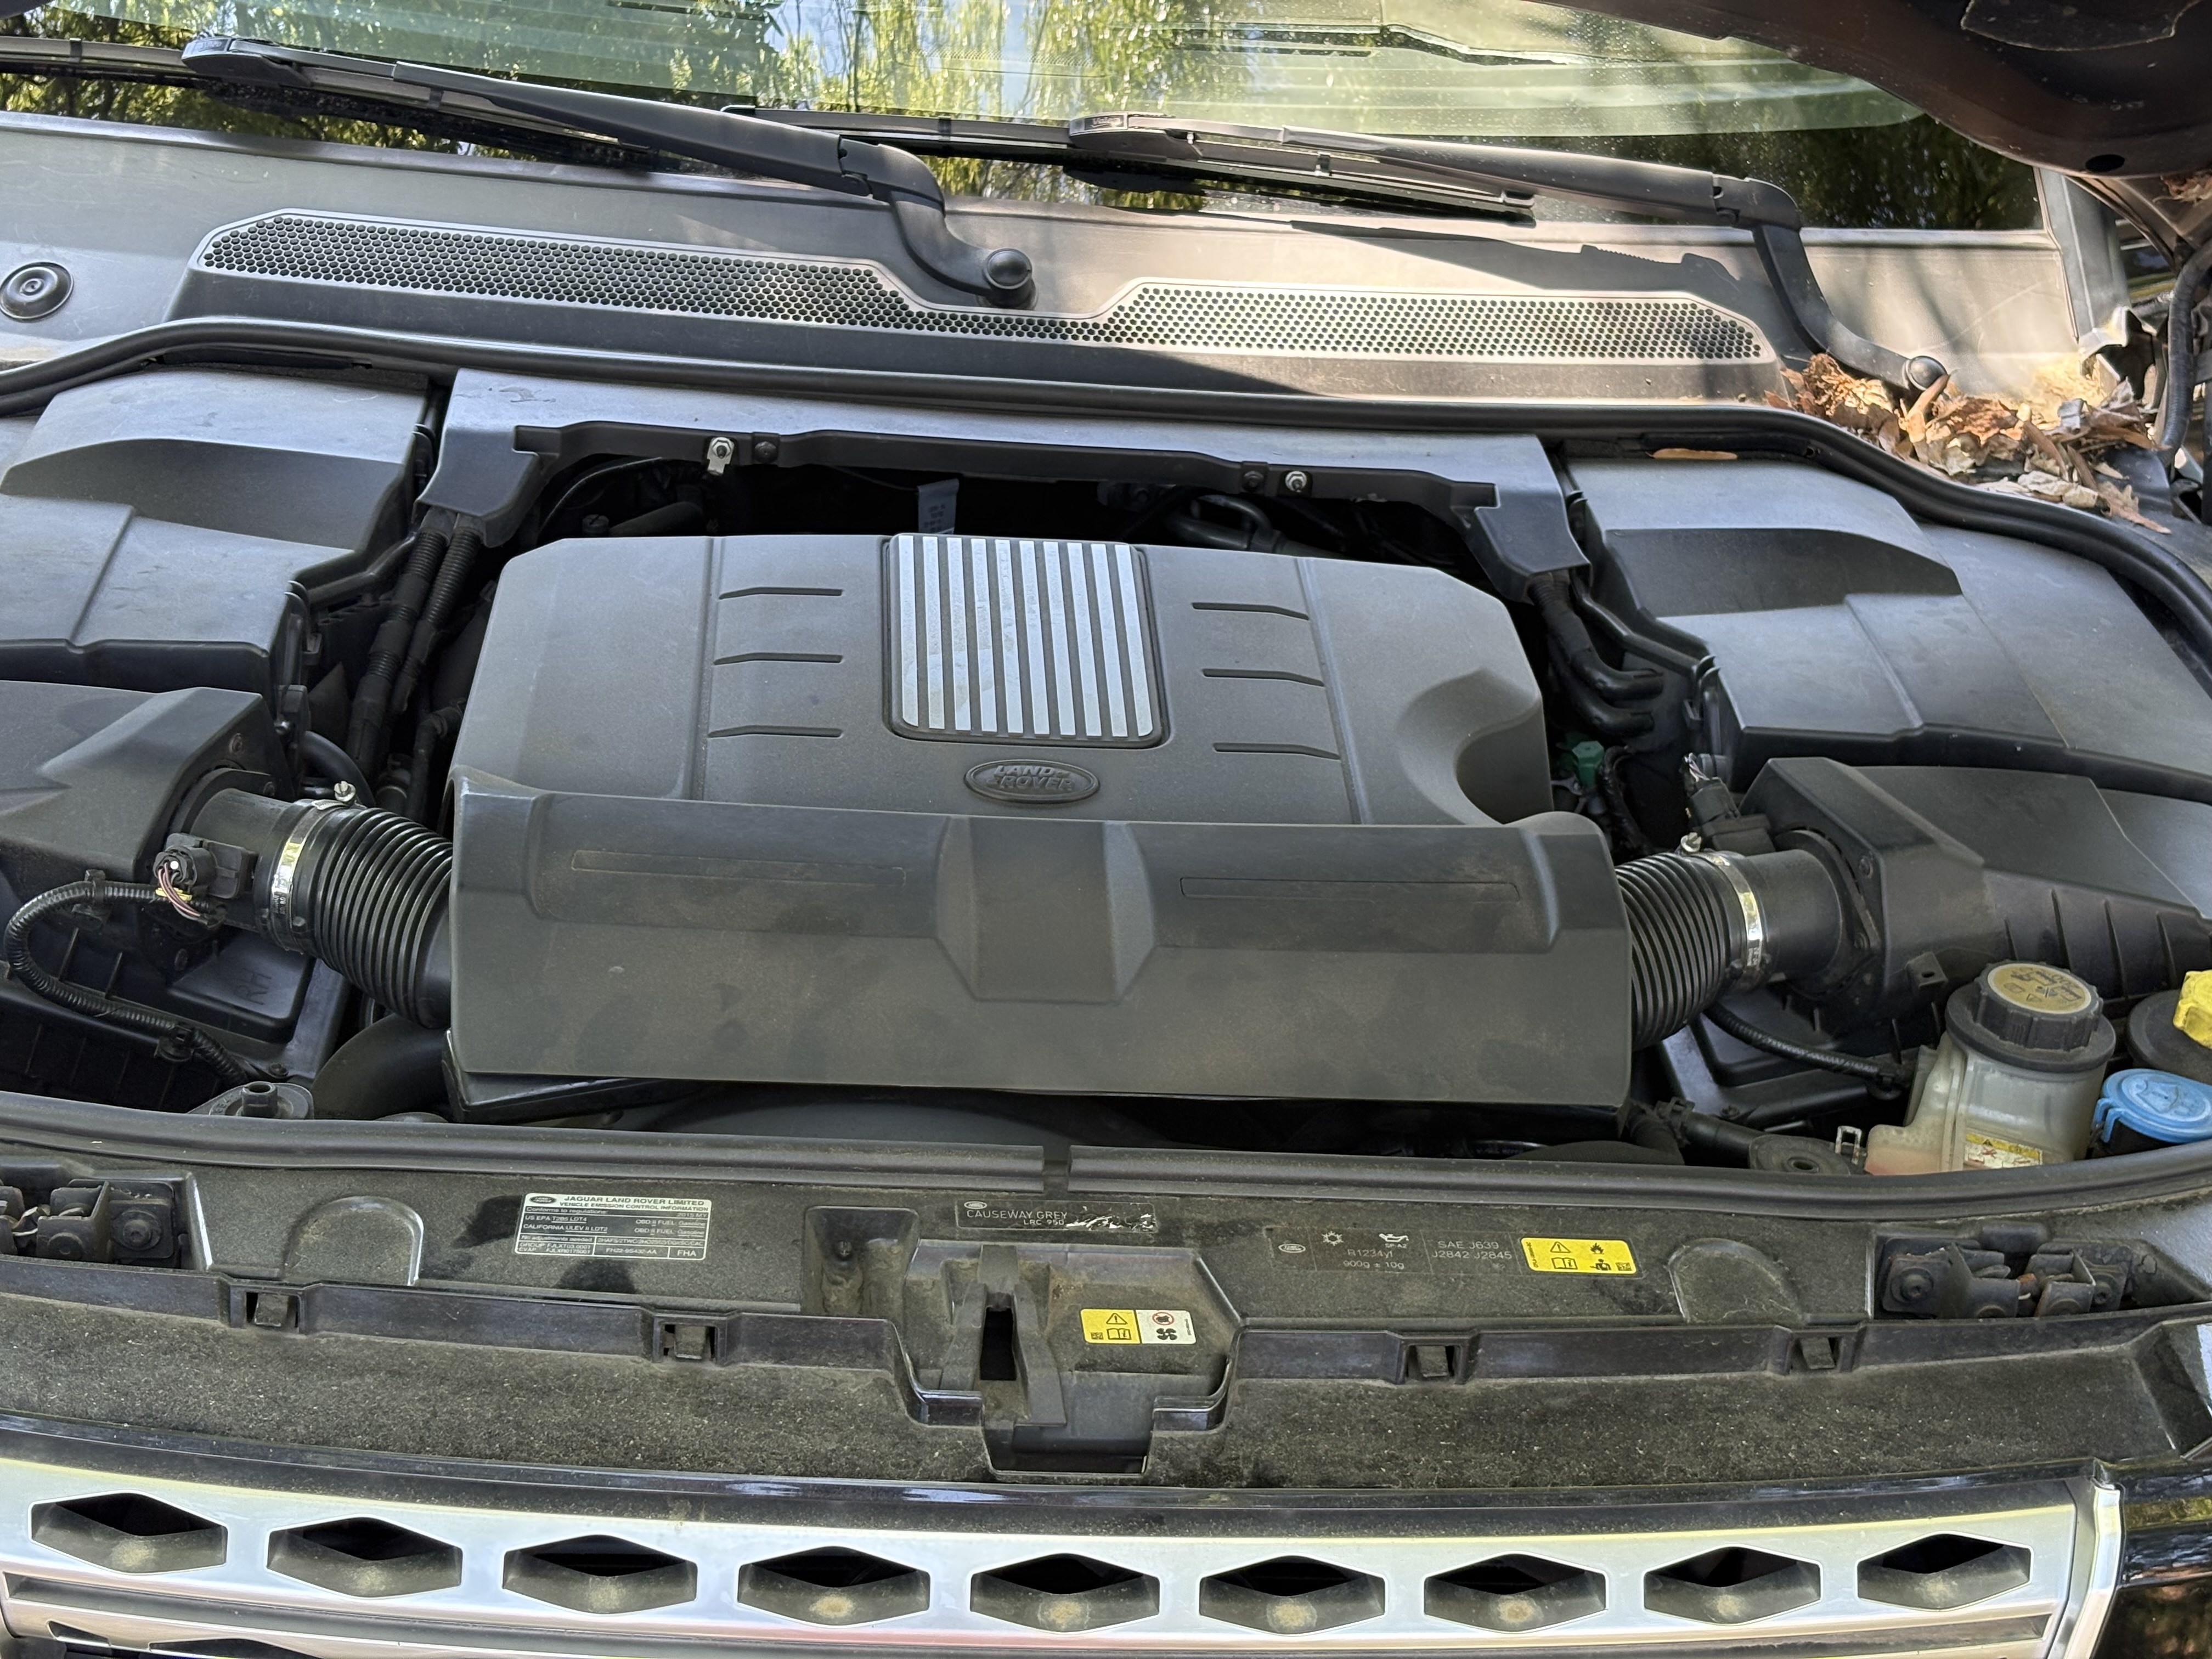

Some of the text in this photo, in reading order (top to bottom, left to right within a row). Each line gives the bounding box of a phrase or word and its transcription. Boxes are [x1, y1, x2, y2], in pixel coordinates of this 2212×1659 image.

[994, 765, 1054, 777] LAND
[1000, 775, 1075, 790] ROVER
[967, 1209, 1068, 1220] CAUSEWAY GREY
[1438, 1241, 1499, 1249] SAE J639
[1431, 1250, 1512, 1259] J2842 J2845
[1343, 1260, 1370, 1268] 900g
